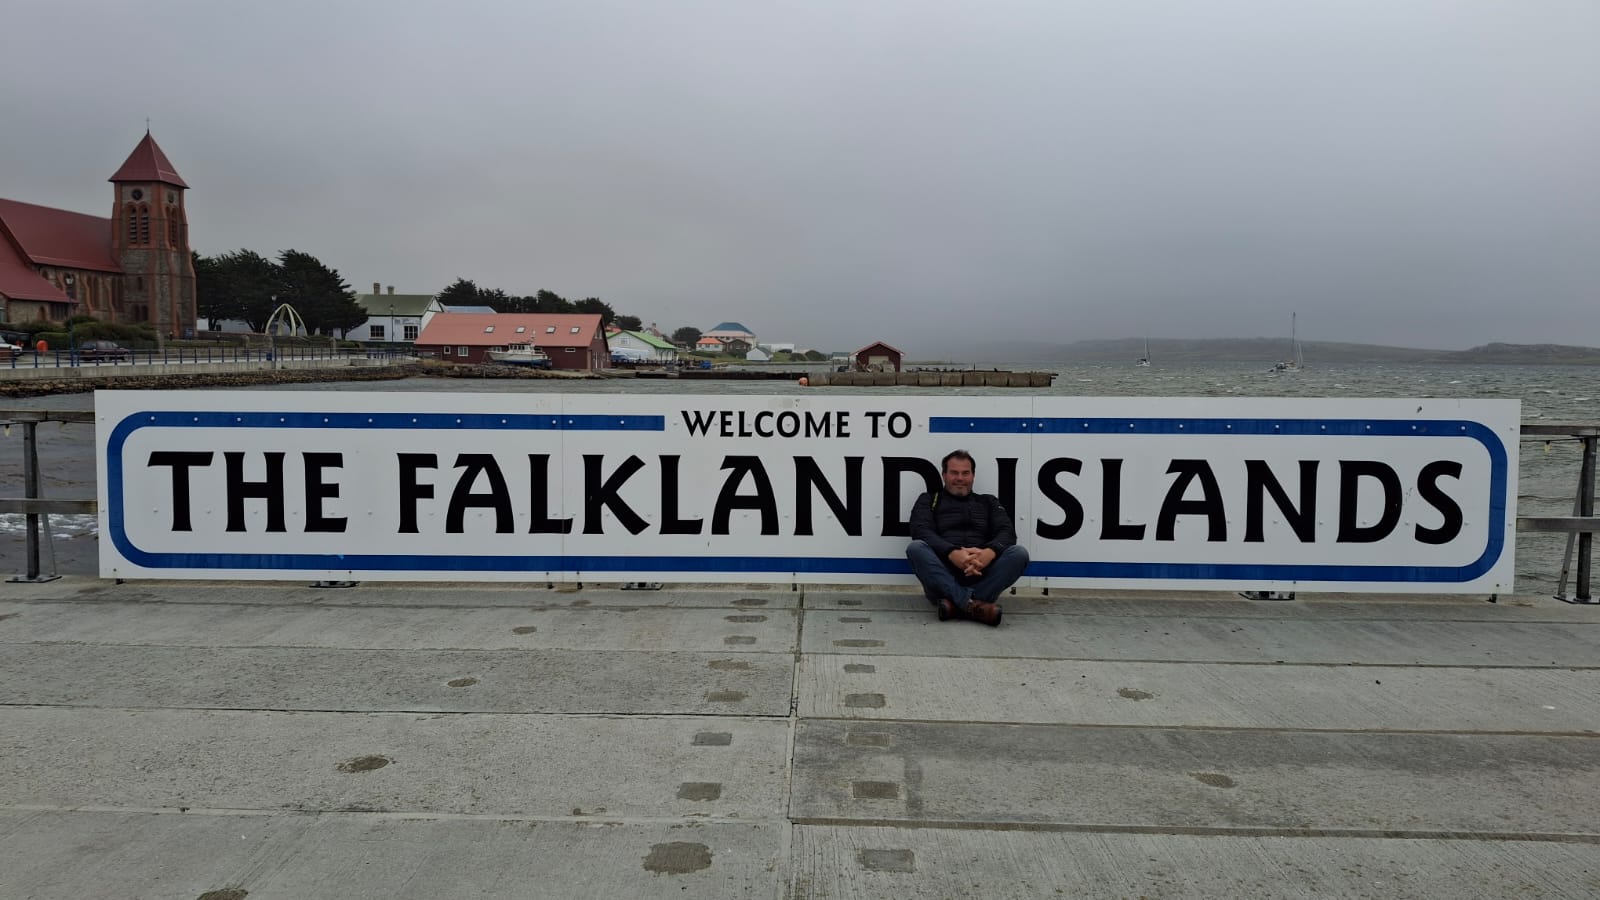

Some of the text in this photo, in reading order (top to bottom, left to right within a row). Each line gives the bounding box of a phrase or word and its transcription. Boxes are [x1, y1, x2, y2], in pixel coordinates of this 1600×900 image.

[681, 410, 912, 439] WELCOME TO
[147, 451, 1464, 545] THE FALKLAND ISLANDS
